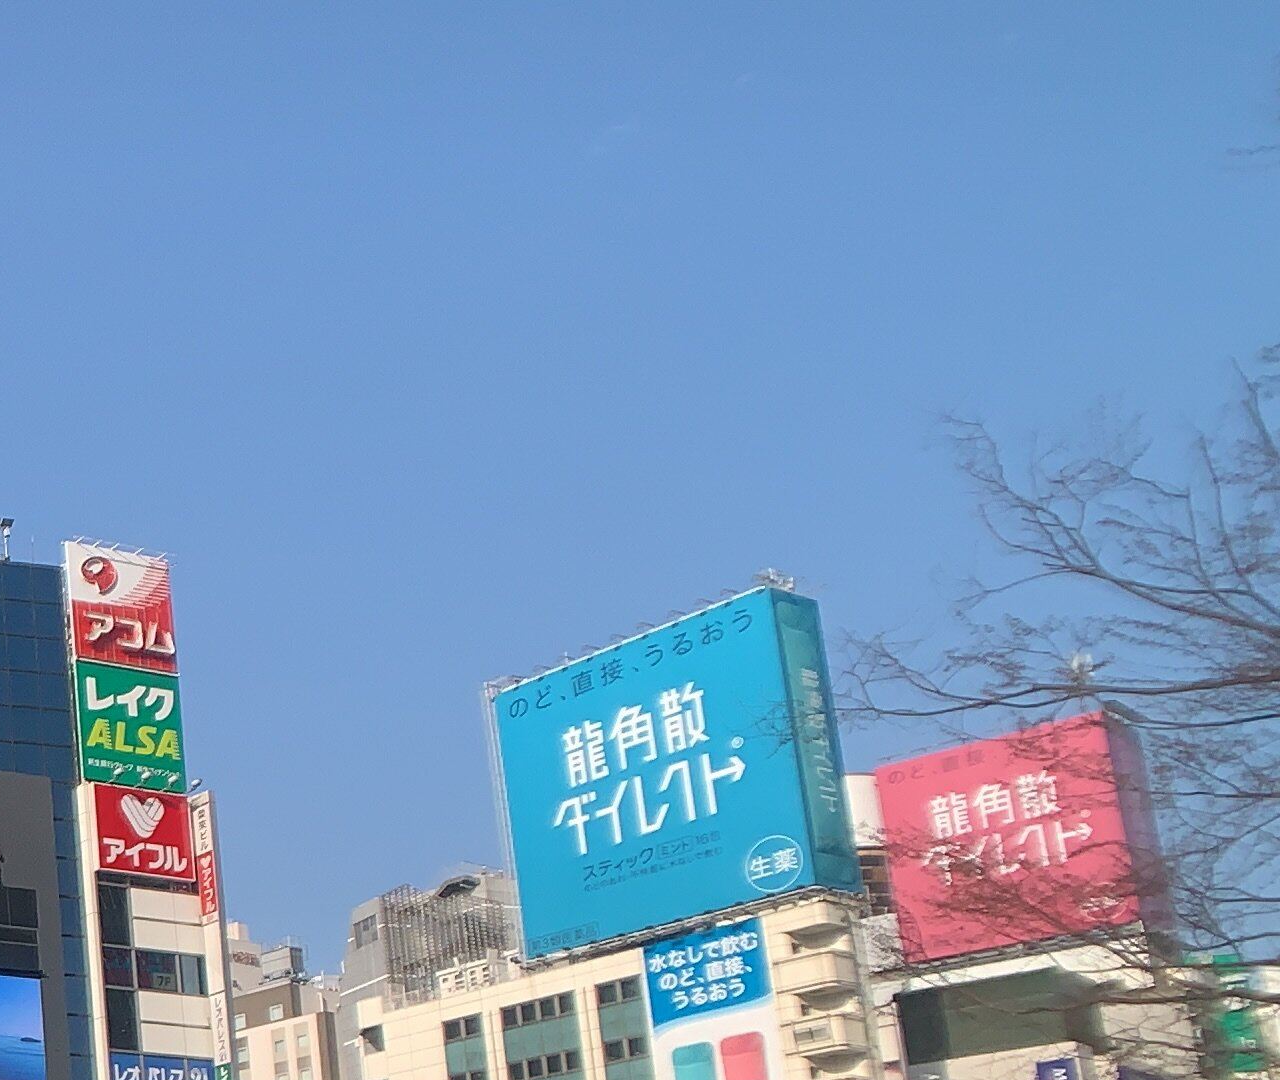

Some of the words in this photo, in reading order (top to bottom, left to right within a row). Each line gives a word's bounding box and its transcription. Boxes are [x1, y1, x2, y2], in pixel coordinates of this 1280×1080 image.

[84, 611, 176, 657] アコム
[508, 608, 755, 720] のど、直接、うるおう
[85, 676, 175, 721] レイク
[86, 718, 181, 761] ALSA
[561, 679, 711, 789] 龍角散
[552, 750, 747, 856] ダイレクト
[102, 837, 188, 874] アイフル
[749, 846, 800, 882] 生薬
[201, 868, 216, 914] アイフル
[648, 930, 759, 974] 水なしで飲む
[671, 976, 747, 1010] うるおう
